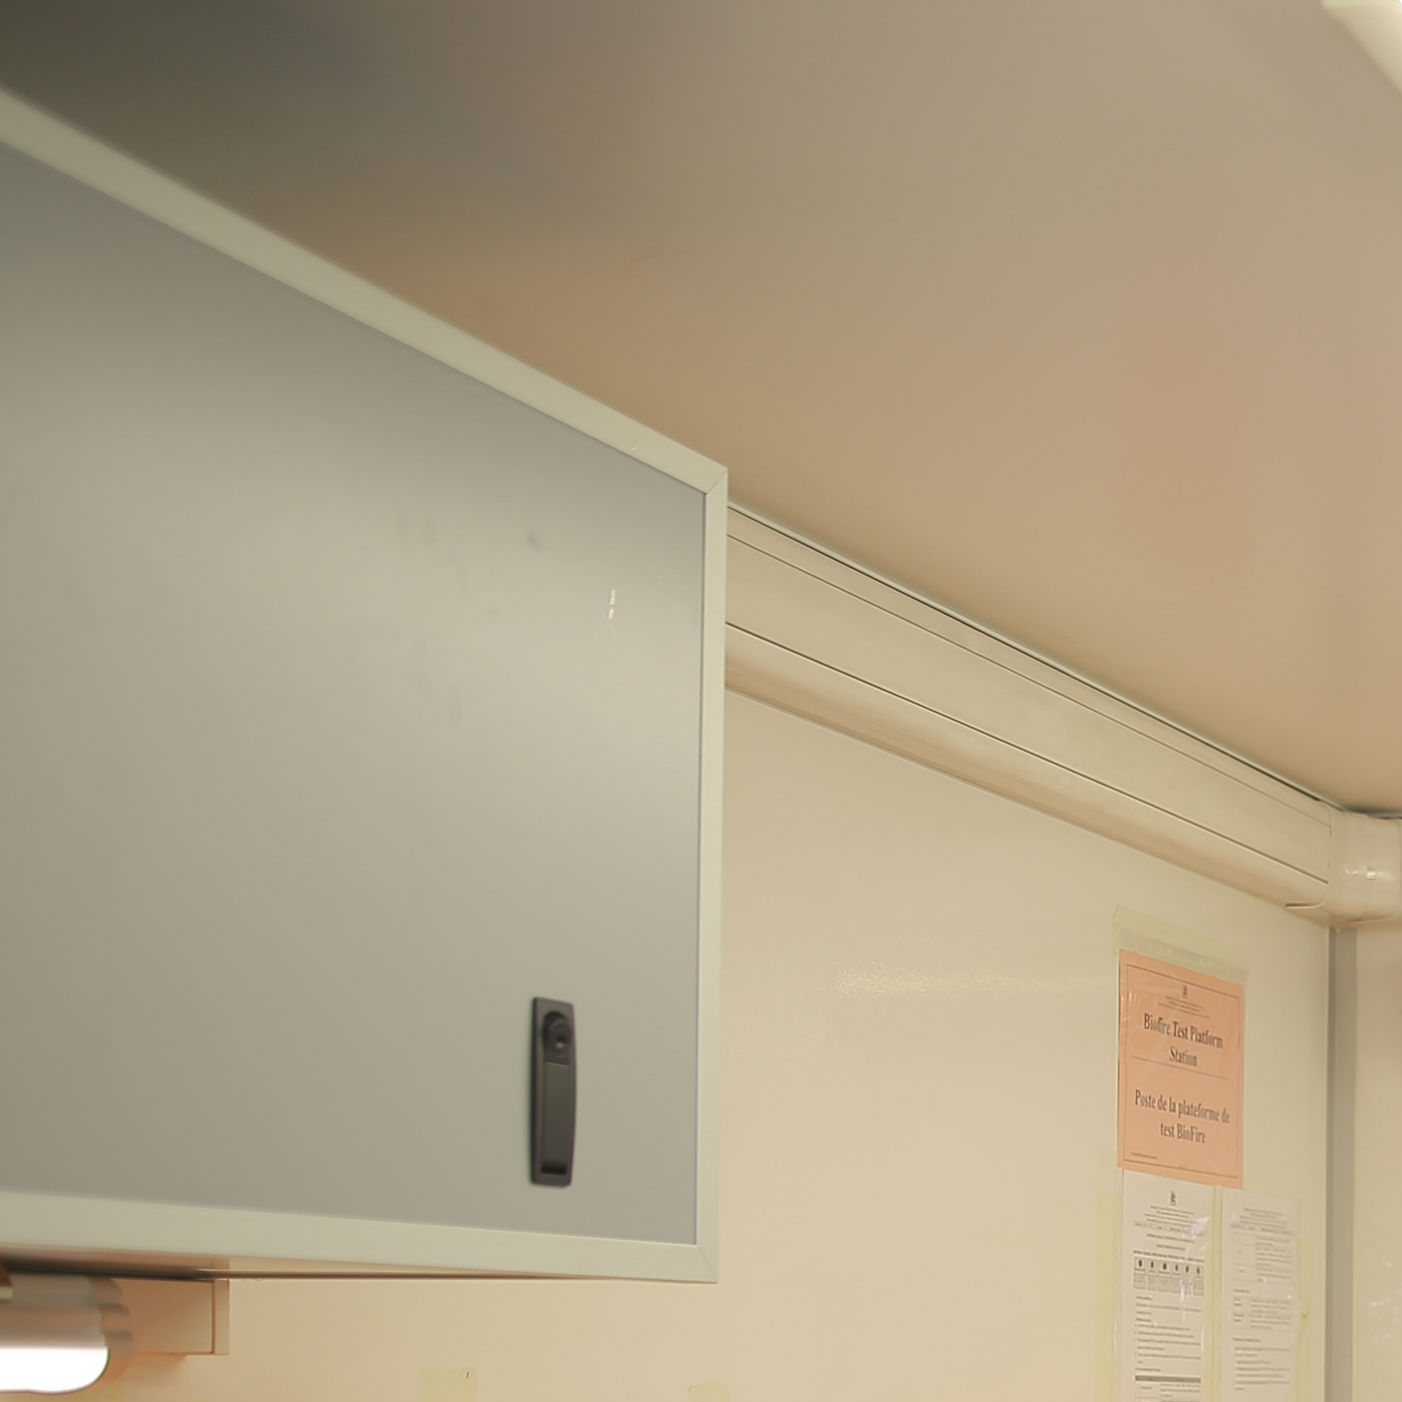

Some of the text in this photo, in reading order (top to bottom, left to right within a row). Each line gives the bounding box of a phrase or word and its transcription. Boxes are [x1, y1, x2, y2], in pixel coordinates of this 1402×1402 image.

[1144, 1013, 1223, 1048] Biofire Test Platform
[1169, 1046, 1198, 1067] Station
[1135, 1089, 1230, 1124] Poste de la plateforme de
[1160, 1123, 1206, 1144] test BioFire
